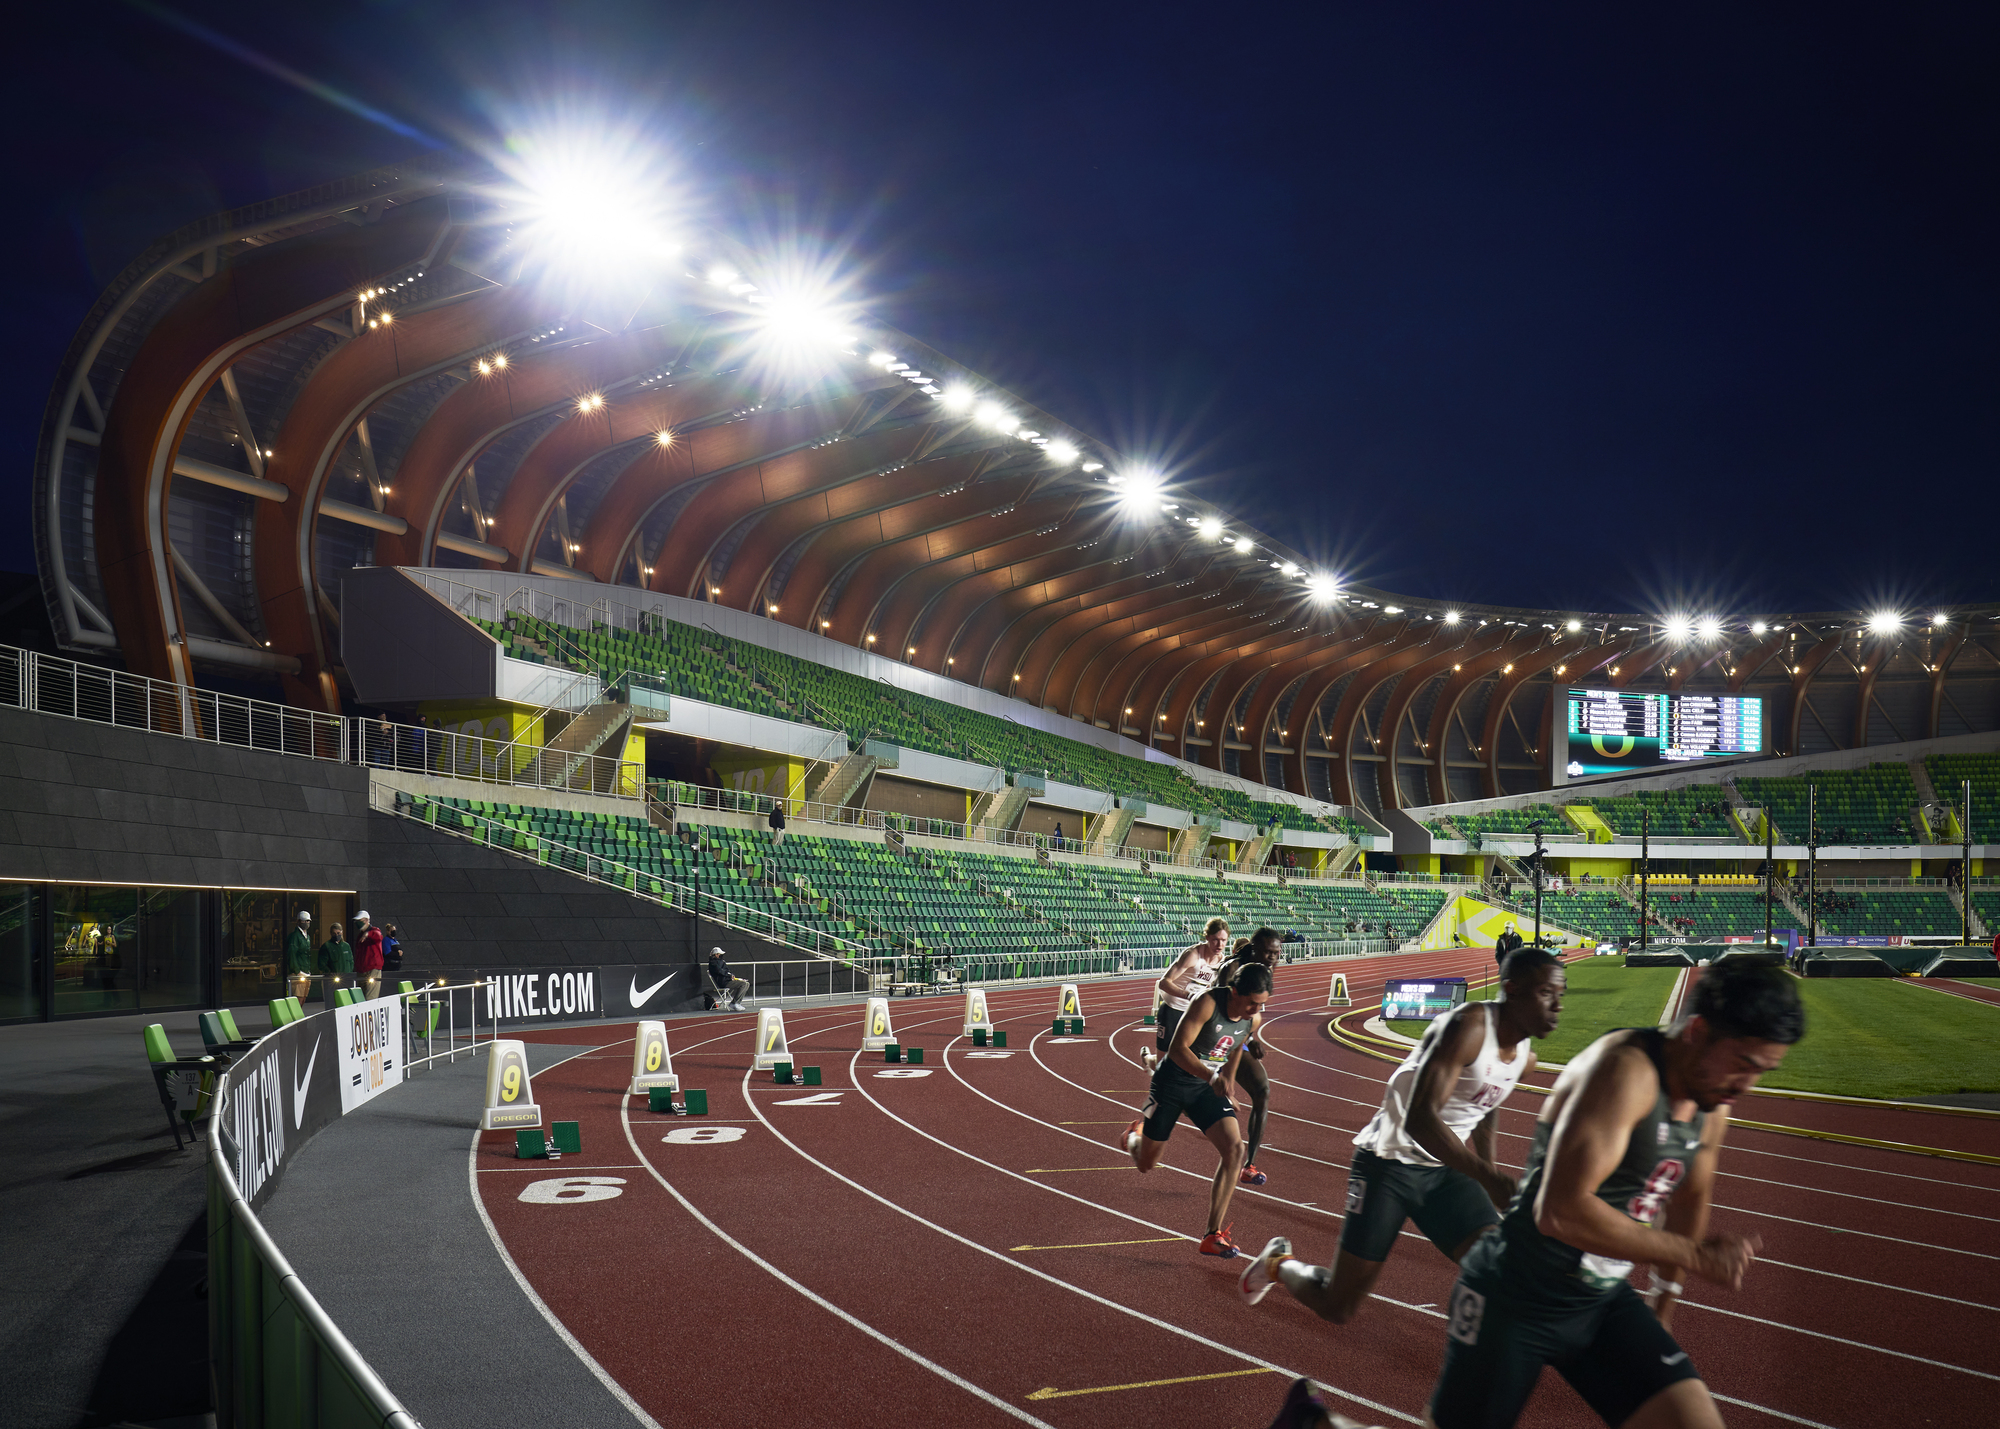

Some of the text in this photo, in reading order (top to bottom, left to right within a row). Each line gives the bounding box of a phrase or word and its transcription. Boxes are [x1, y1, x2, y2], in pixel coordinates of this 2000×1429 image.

[1197, 971, 1212, 981] WSU
[486, 972, 594, 1018] NIKE.COM
[1337, 983, 1342, 996] 1
[1386, 992, 1426, 1002] 3 DURFEE
[1419, 985, 1435, 993] 200M
[972, 1002, 982, 1022] 5
[1064, 996, 1075, 1014] 4
[351, 1006, 389, 1059] JOURNEY
[873, 1013, 886, 1035] 6
[766, 1025, 780, 1051] 7
[646, 1040, 662, 1072] 8
[185, 1073, 196, 1081] 137
[361, 1052, 383, 1094] TO GOLD
[188, 1085, 193, 1096] A
[501, 1065, 521, 1102] 9
[1143, 1096, 1155, 1112] 7
[235, 1048, 285, 1202] NIKE.COM
[493, 1114, 537, 1122] OREGON
[661, 1126, 747, 1144] 8
